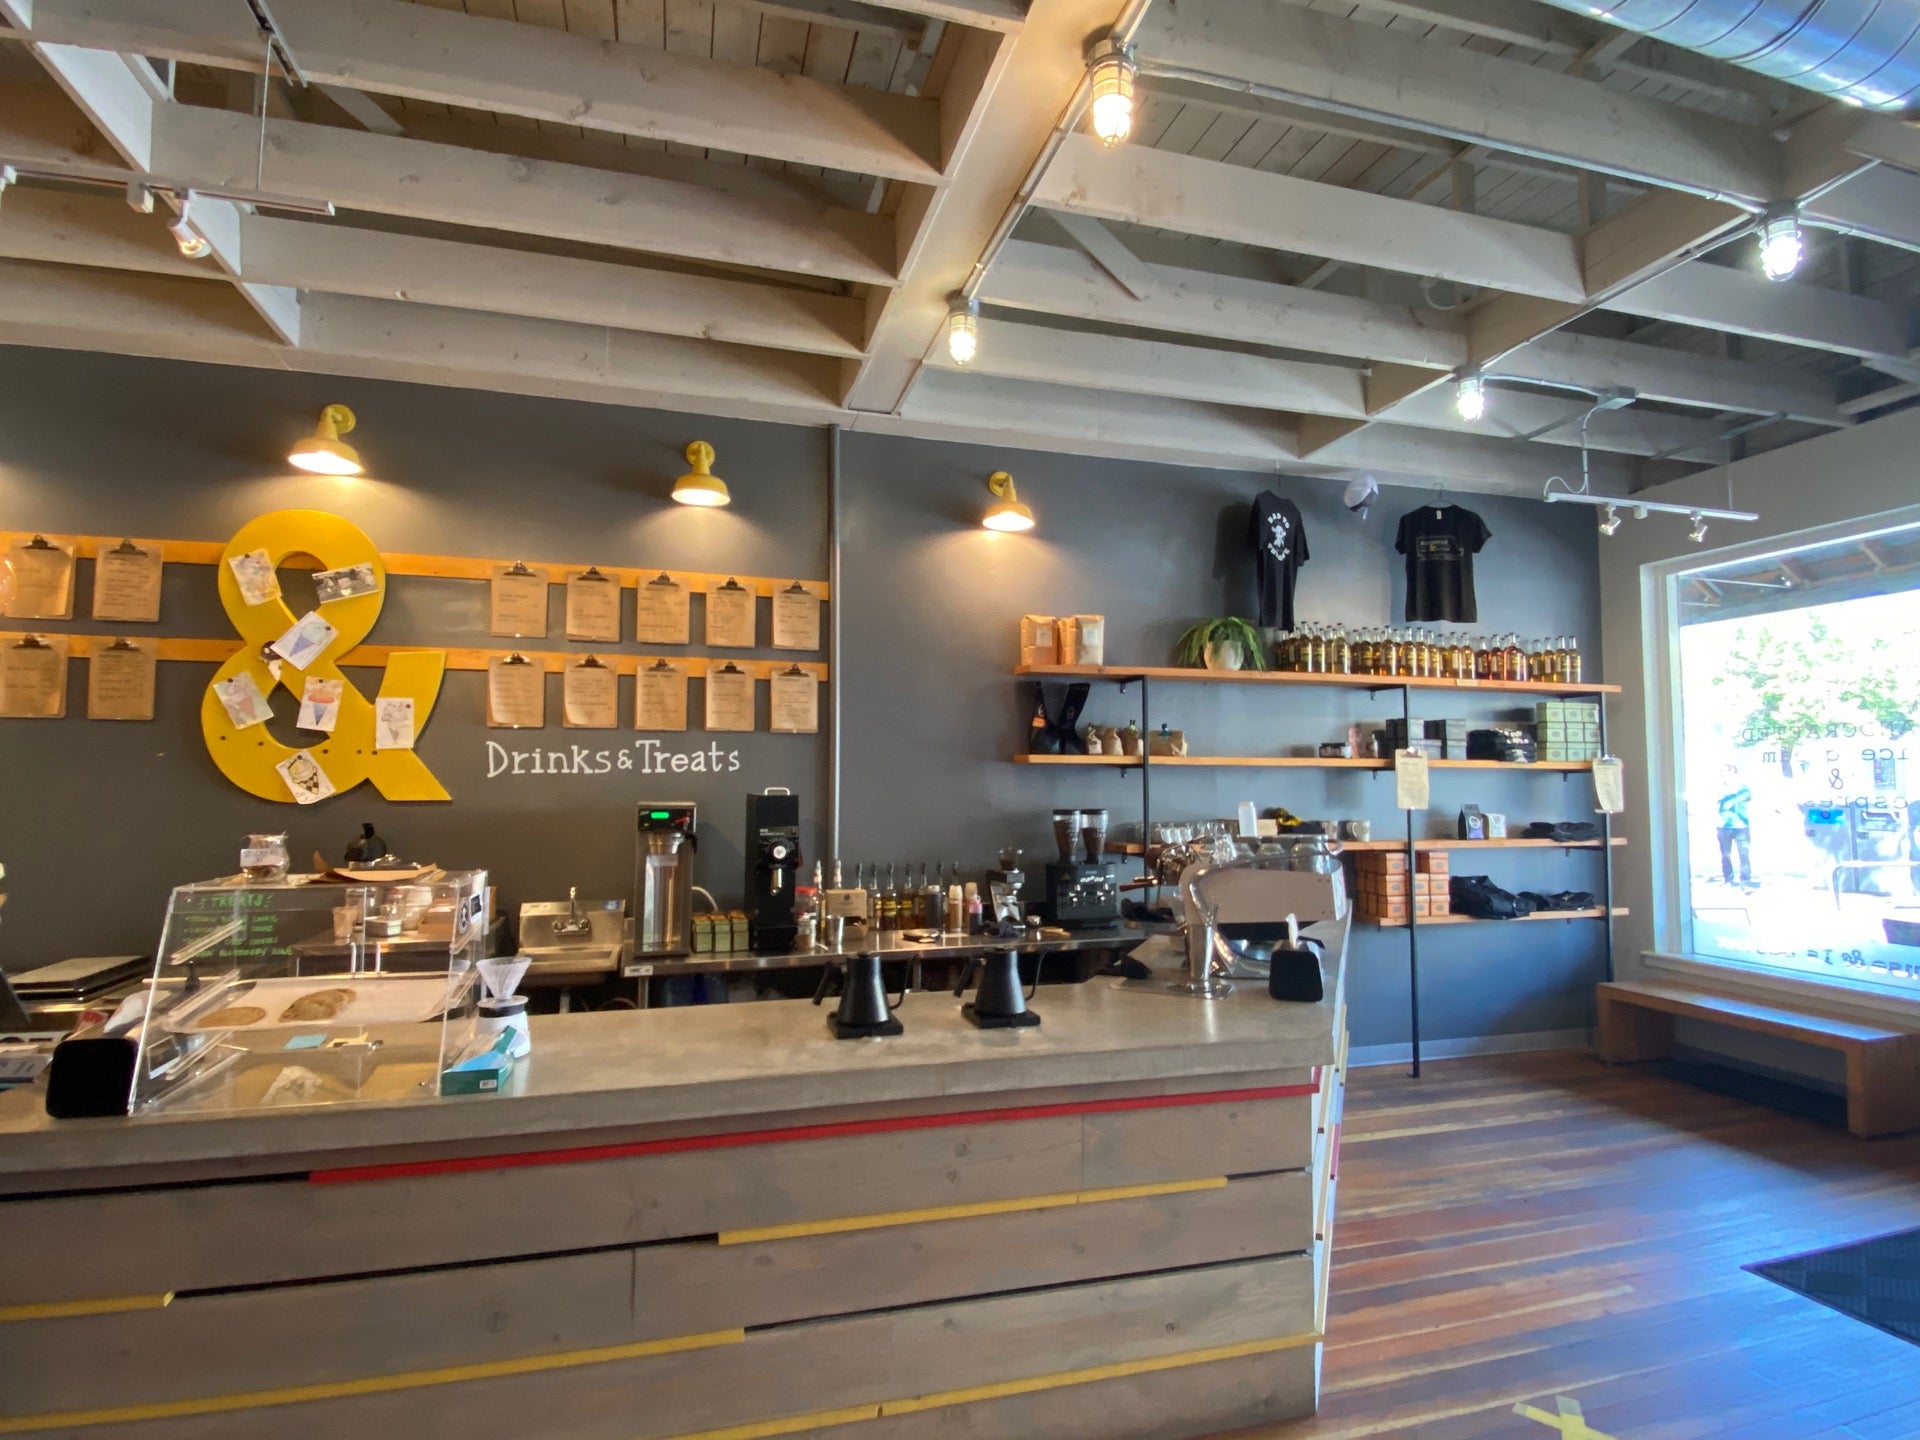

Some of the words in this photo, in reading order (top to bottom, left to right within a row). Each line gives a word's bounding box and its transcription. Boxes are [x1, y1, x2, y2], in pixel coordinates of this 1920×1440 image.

[485, 740, 612, 778] Drinks
[616, 749, 633, 770] &
[635, 739, 741, 774] Treats
